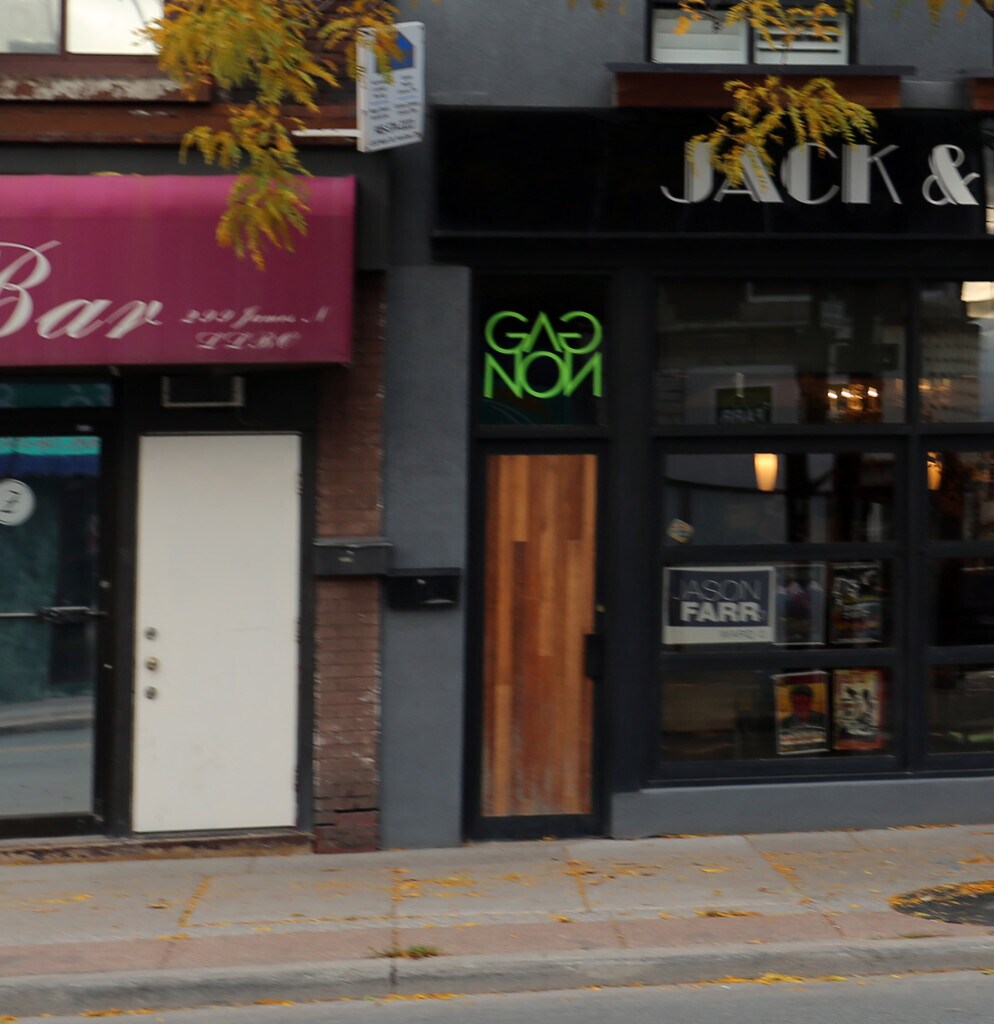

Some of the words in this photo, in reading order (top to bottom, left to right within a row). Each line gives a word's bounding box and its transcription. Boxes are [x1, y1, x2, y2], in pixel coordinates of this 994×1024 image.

[660, 144, 902, 205] JACK
[922, 144, 980, 206] &
[0, 240, 163, 340] Bar
[680, 601, 761, 623] FARR
